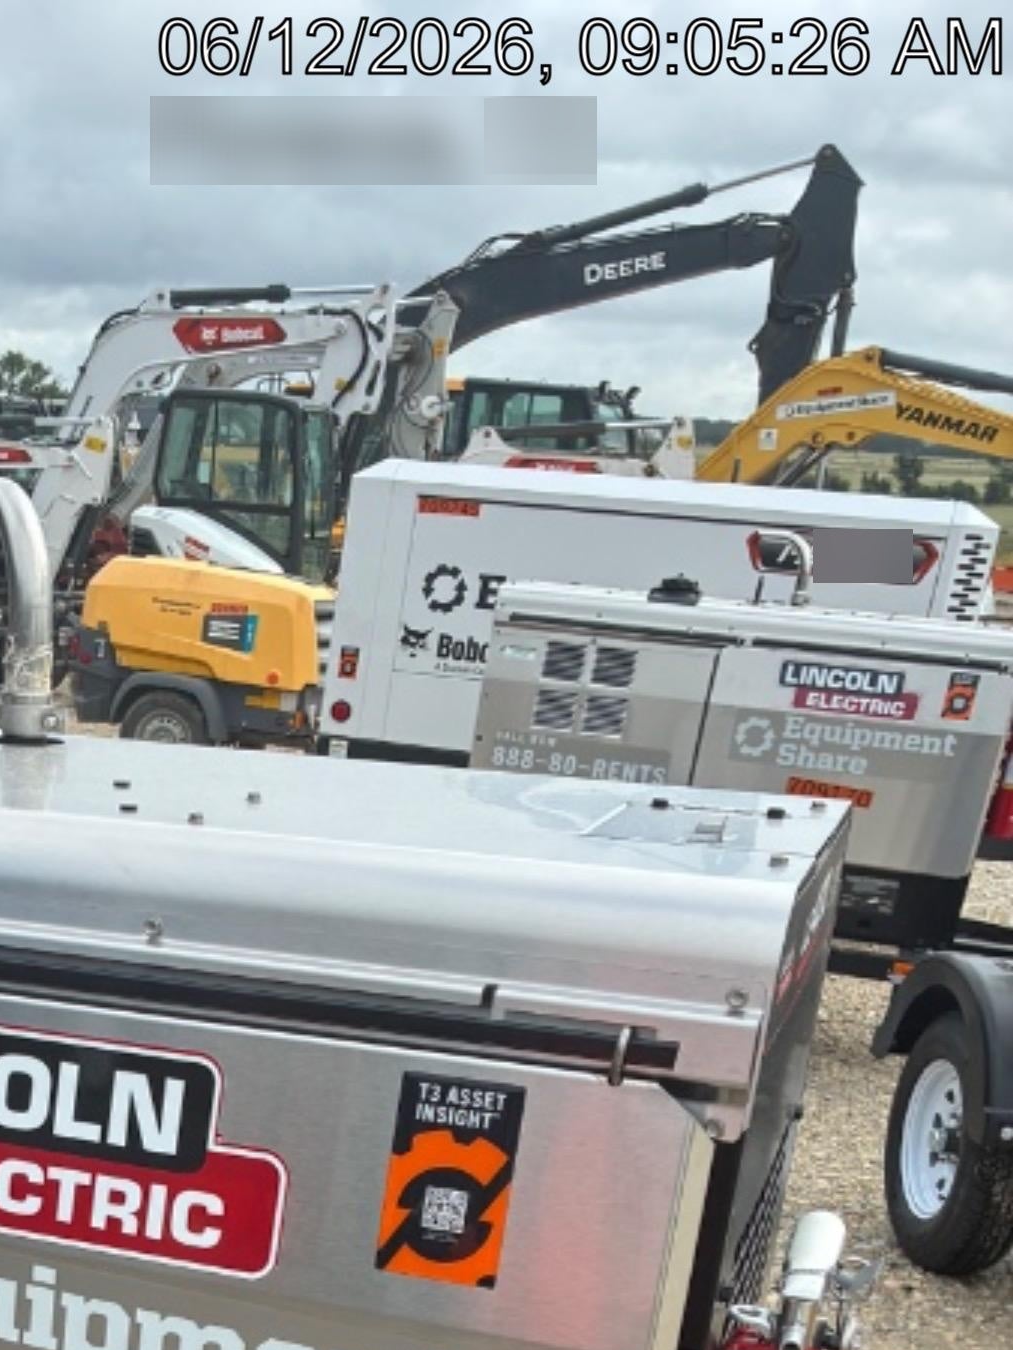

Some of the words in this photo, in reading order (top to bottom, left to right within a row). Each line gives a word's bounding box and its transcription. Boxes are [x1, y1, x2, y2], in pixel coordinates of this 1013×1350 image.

[584, 251, 666, 286] DEERE
[895, 401, 999, 444] YANMAR
[785, 665, 899, 694] LINCOLN
[806, 692, 906, 716] ELECTRIC
[783, 716, 957, 757] Equipment
[491, 746, 666, 783] 888-80-RENTS
[776, 743, 867, 774] Share
[418, 1082, 441, 1101] T3
[445, 1086, 507, 1111] ASSET
[415, 1103, 494, 1129] INSIGHT
